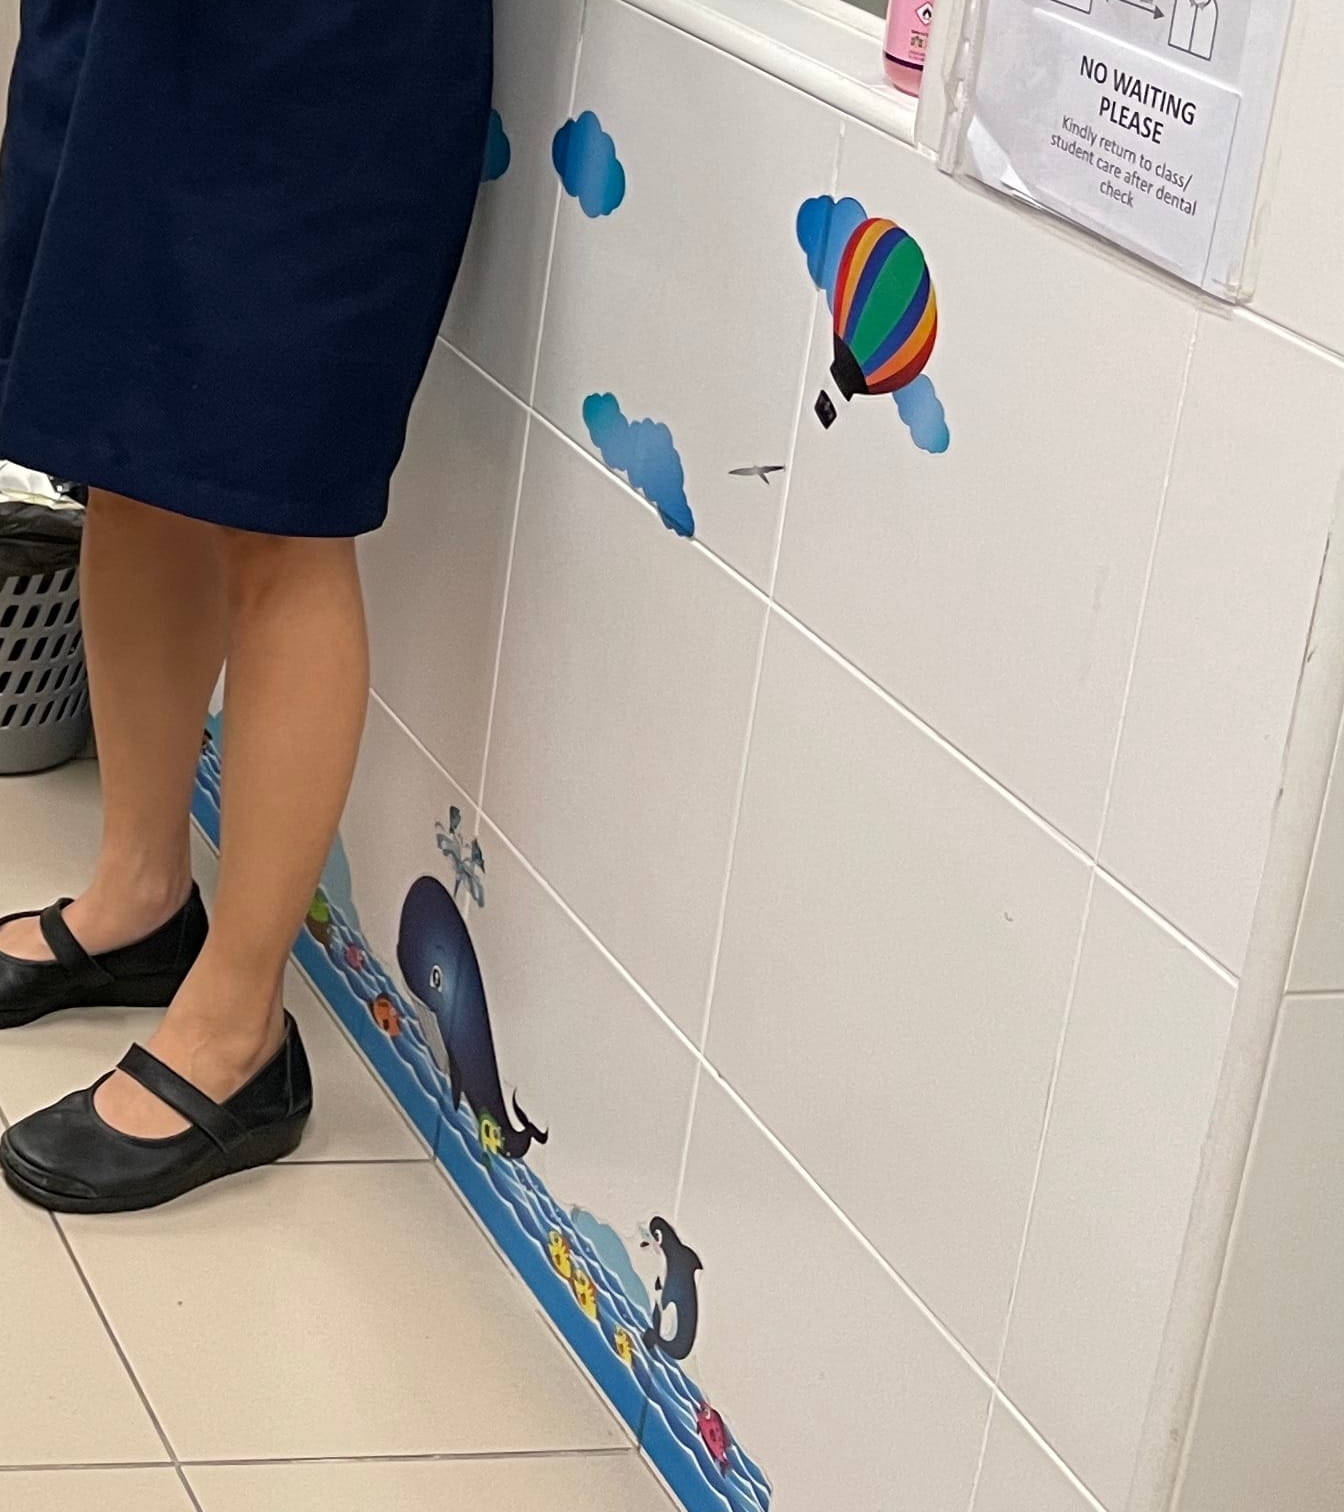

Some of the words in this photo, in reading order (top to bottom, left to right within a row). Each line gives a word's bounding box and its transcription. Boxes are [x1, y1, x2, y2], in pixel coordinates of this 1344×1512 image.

[1080, 55, 1108, 84] NO
[1113, 69, 1197, 125] WAITING
[1099, 96, 1164, 144] PLEASE
[1050, 133, 1094, 166] student
[1096, 157, 1122, 179] care
[1124, 170, 1154, 195] after
[1155, 187, 1198, 216] dental
[1061, 115, 1098, 145] Kindly
[1099, 136, 1137, 164] return
[1139, 154, 1153, 172] to
[1155, 163, 1194, 192] class/
[1099, 179, 1135, 208] check
